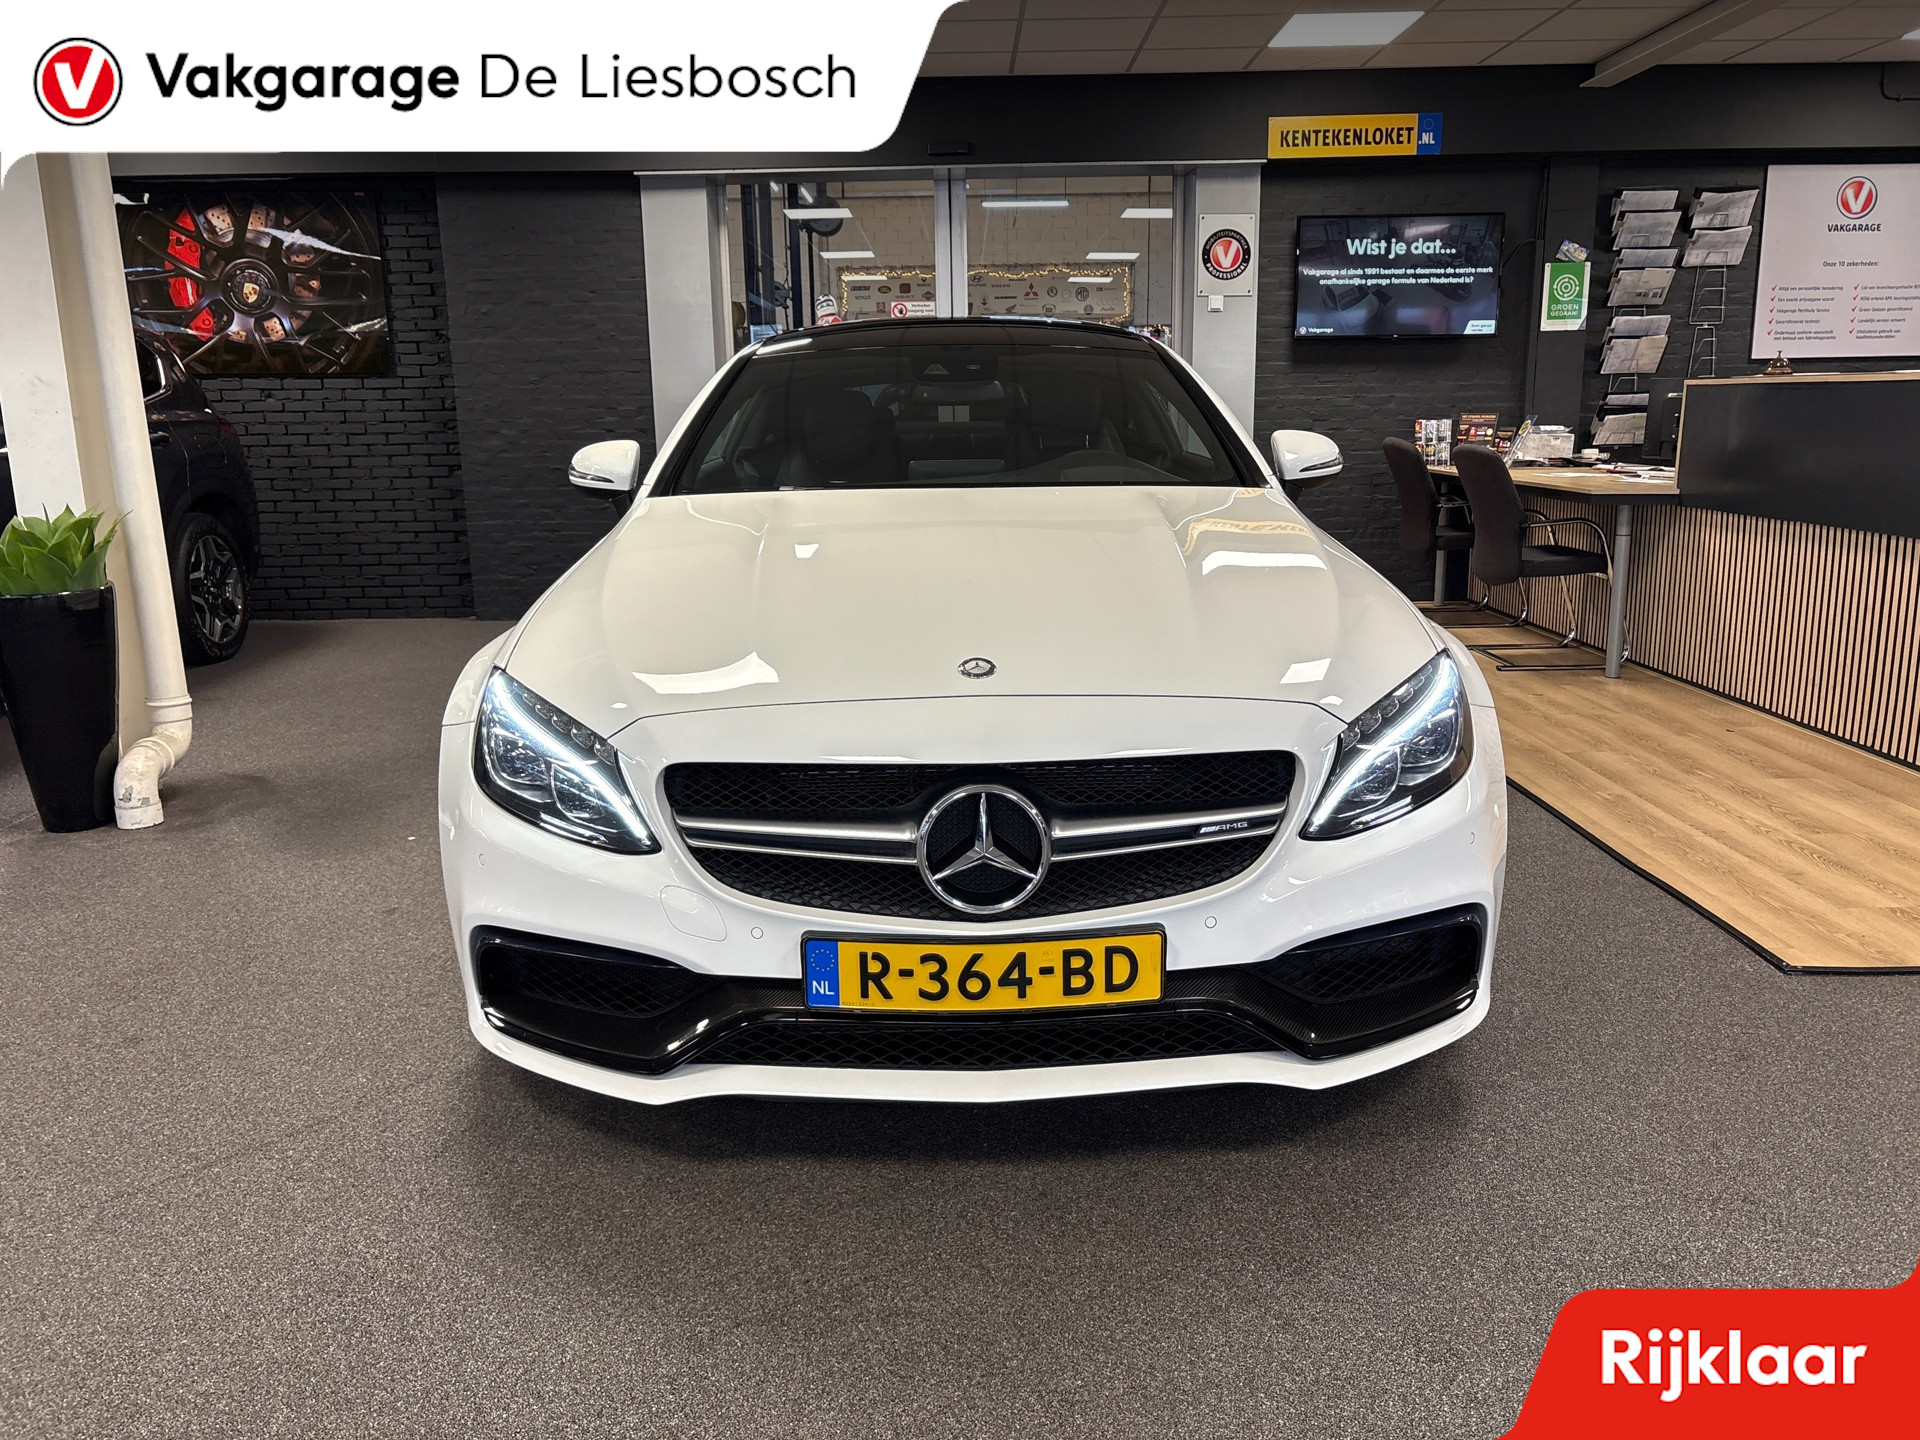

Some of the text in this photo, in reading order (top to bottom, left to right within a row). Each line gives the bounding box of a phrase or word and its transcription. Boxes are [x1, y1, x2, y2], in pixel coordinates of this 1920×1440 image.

[1280, 127, 1415, 148] KENTEKENLOKET
[1827, 223, 1882, 233] VAKGARAGE
[1346, 238, 1457, 259] Wist je dat...
[1205, 262, 1248, 279] PROFESSIONAL
[1302, 268, 1339, 277] Vakgarage
[858, 945, 1140, 1002] R-364-BD
[812, 980, 835, 996] NL
